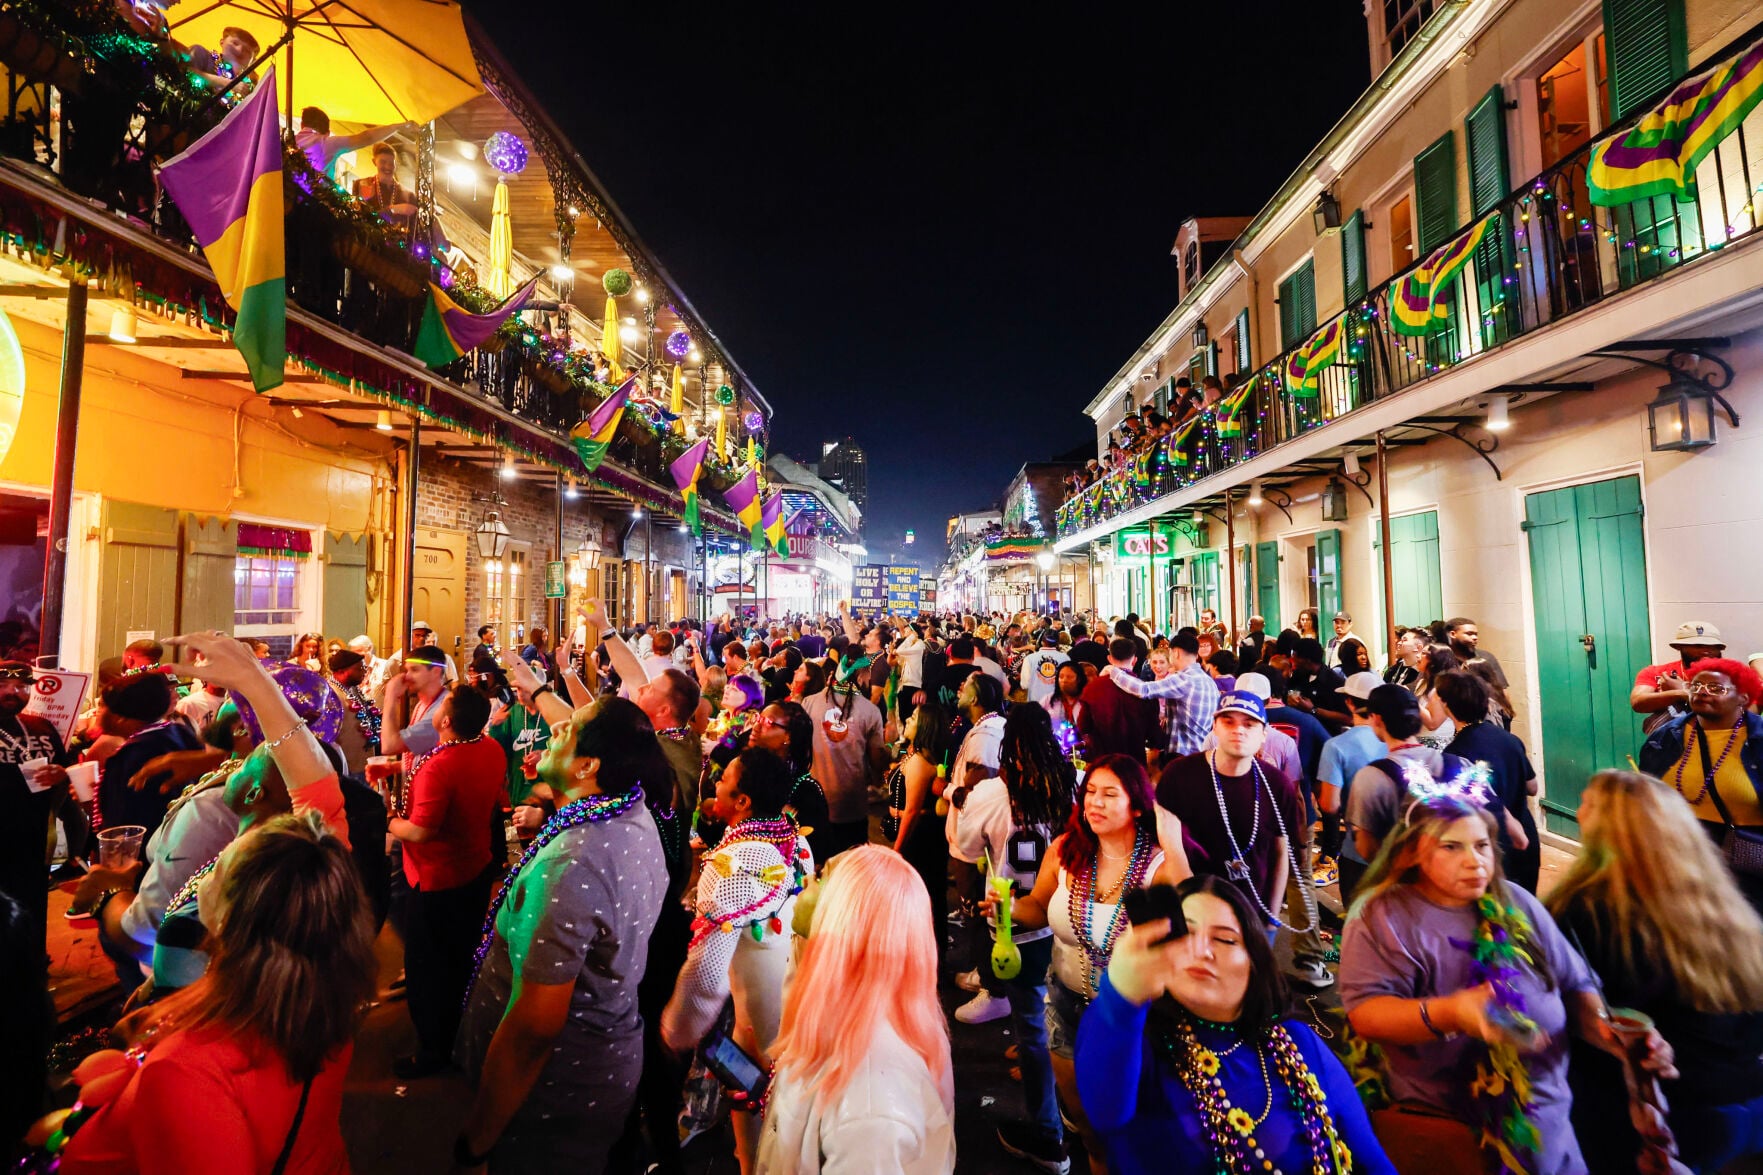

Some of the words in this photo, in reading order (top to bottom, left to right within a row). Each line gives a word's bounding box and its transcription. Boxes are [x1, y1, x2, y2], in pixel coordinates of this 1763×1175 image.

[424, 555, 438, 564] 700
[856, 567, 879, 577] LIVE
[889, 567, 918, 576] REPENT
[855, 577, 878, 587] HOLY
[860, 588, 873, 597] OR
[889, 584, 918, 592] BELIEVE
[896, 592, 911, 600] THE
[852, 598, 881, 607] HELLFIRE
[889, 600, 917, 609] GOSPEL
[33, 695, 55, 703] Friday
[517, 728, 541, 742] NIKE
